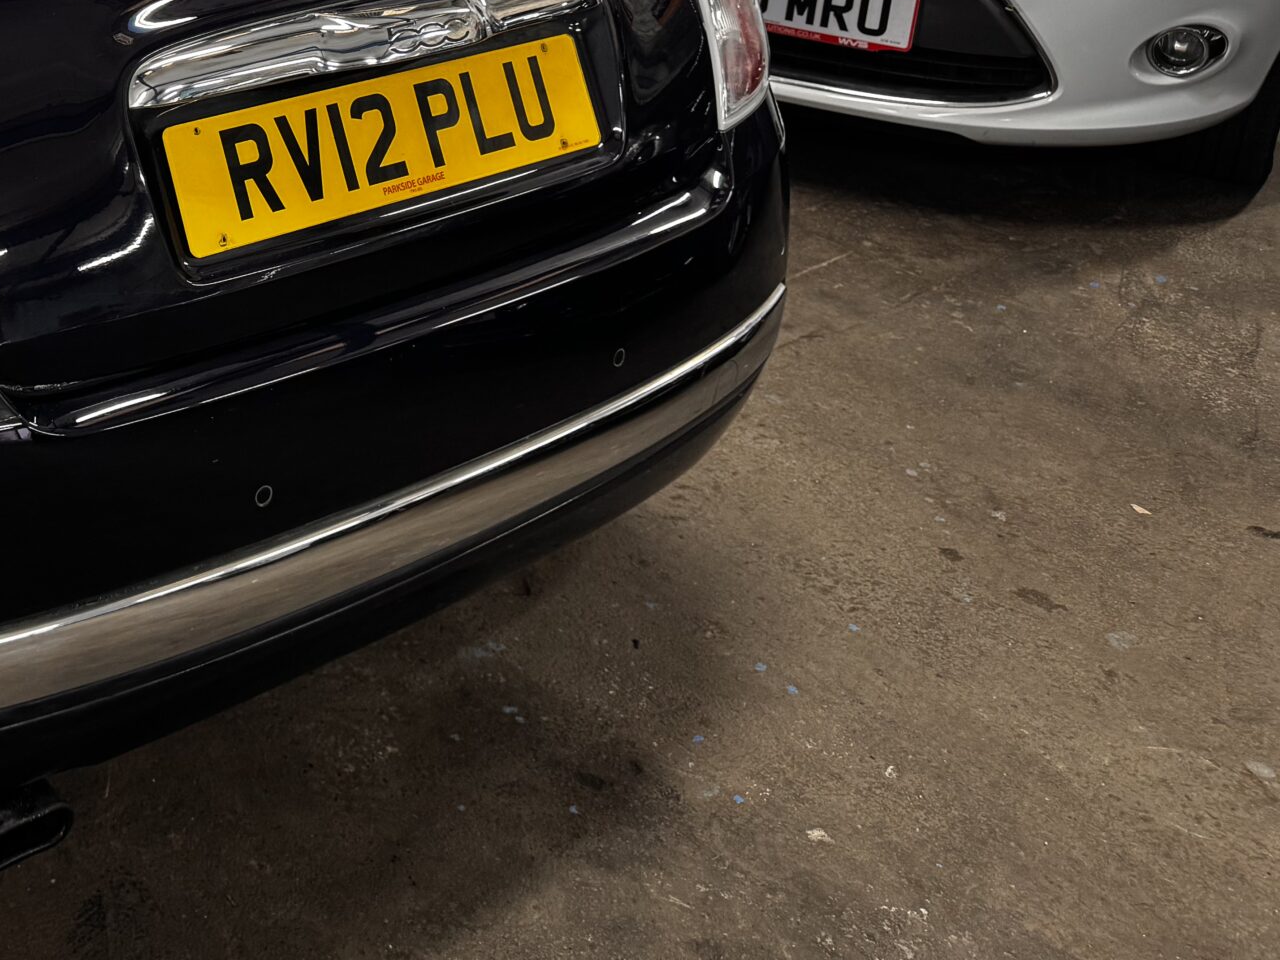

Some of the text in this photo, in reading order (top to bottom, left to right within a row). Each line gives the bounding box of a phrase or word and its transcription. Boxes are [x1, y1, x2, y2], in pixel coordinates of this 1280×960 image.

[218, 55, 556, 221] RV12 PLU
[382, 171, 445, 196] PARKSIDE GARAGE
